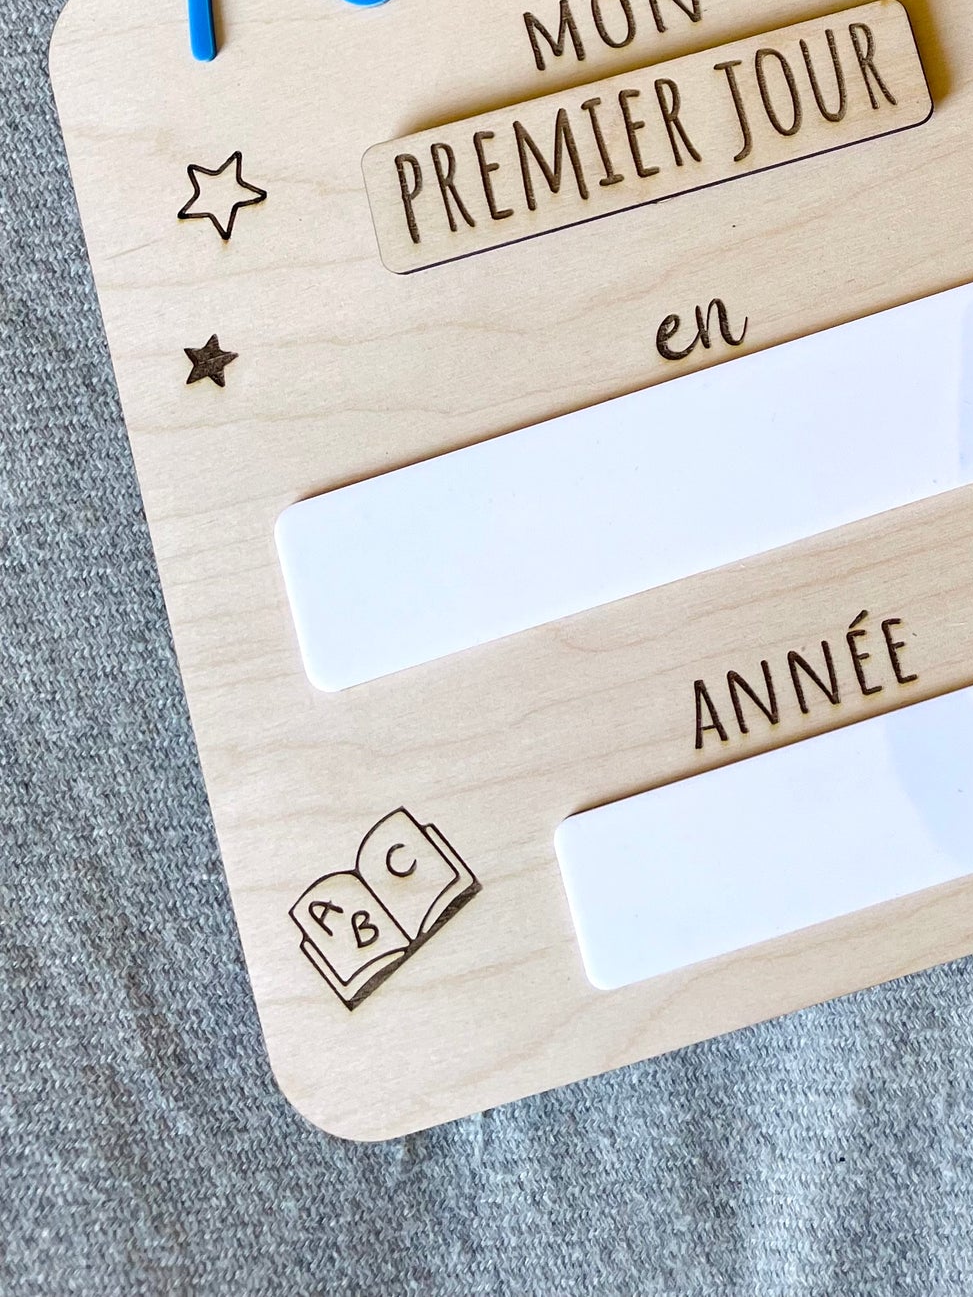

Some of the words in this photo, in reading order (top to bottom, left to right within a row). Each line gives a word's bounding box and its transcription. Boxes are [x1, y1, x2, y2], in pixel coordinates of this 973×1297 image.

[394, 77, 703, 245] PREMIER
[714, 22, 898, 162] JOUR
[656, 298, 748, 361] en
[694, 610, 918, 750] ANNÉE
